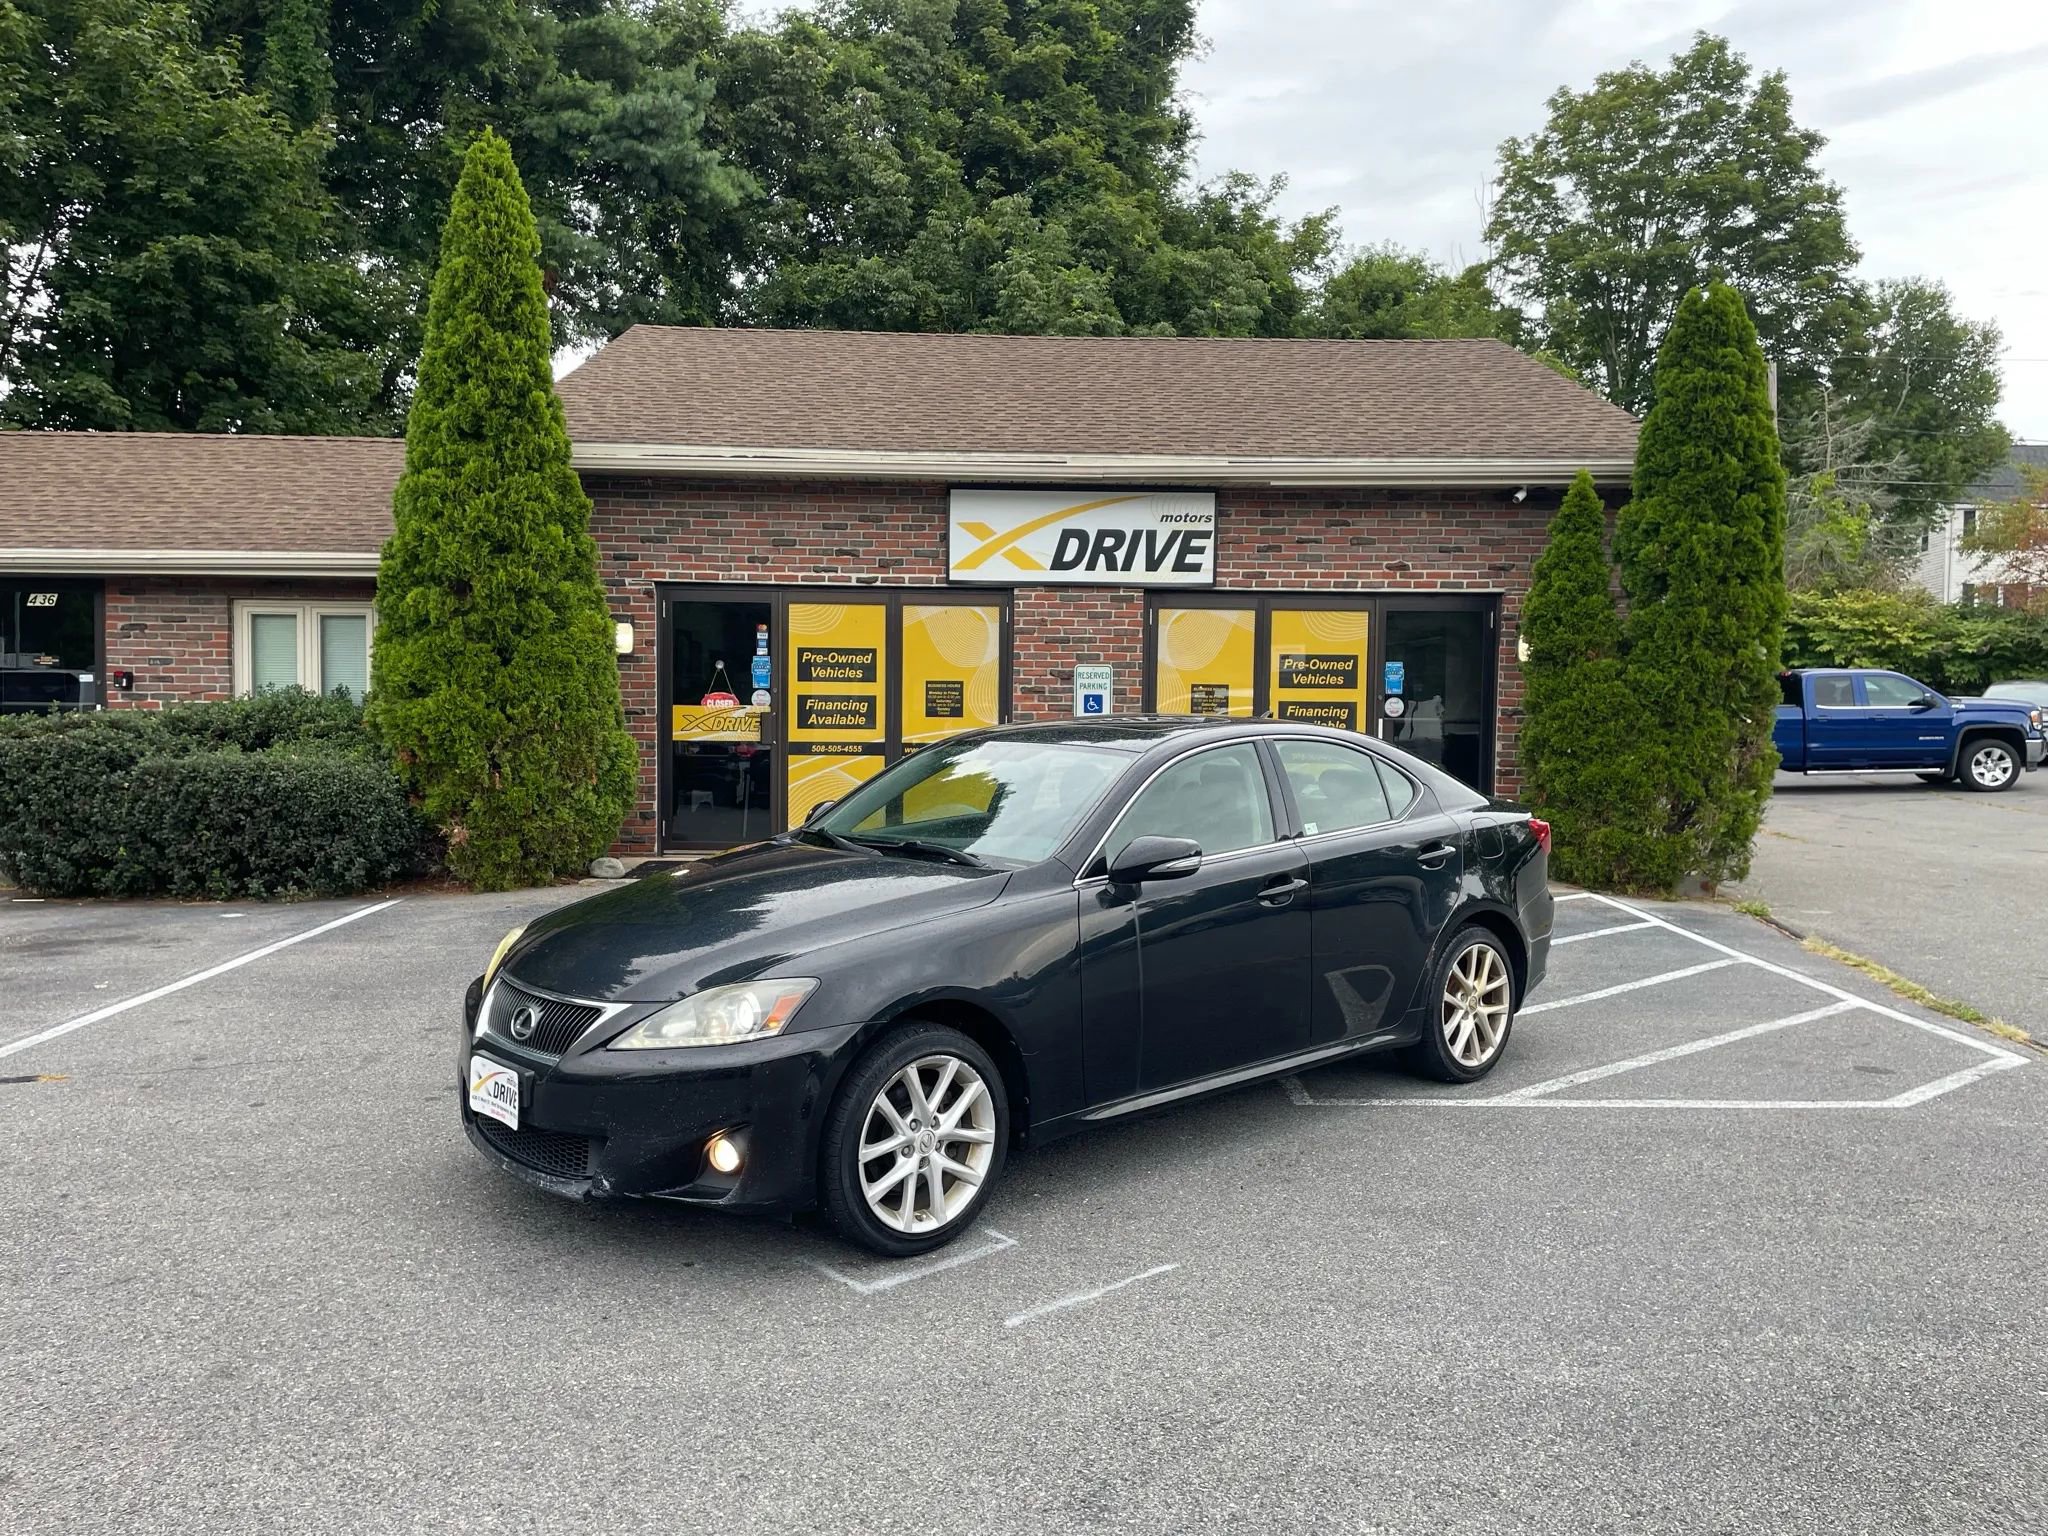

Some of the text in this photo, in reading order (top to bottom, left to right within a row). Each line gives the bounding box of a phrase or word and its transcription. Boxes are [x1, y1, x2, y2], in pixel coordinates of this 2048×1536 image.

[1160, 513, 1212, 523] motors
[1050, 528, 1213, 572] DRIVE
[29, 594, 56, 605] 436
[802, 652, 872, 663] Pre-Owned
[1284, 659, 1353, 670] Pre-Owned
[811, 667, 863, 678] Vehicles
[1293, 674, 1344, 684] Vehicles
[707, 700, 733, 708] CLOSED
[806, 700, 868, 713] Financing
[1287, 706, 1348, 719] Financing
[712, 717, 760, 732] DRIVE
[808, 714, 865, 725] Available
[811, 745, 862, 753] 508-505-4555
[493, 1081, 517, 1110] DRIVE
